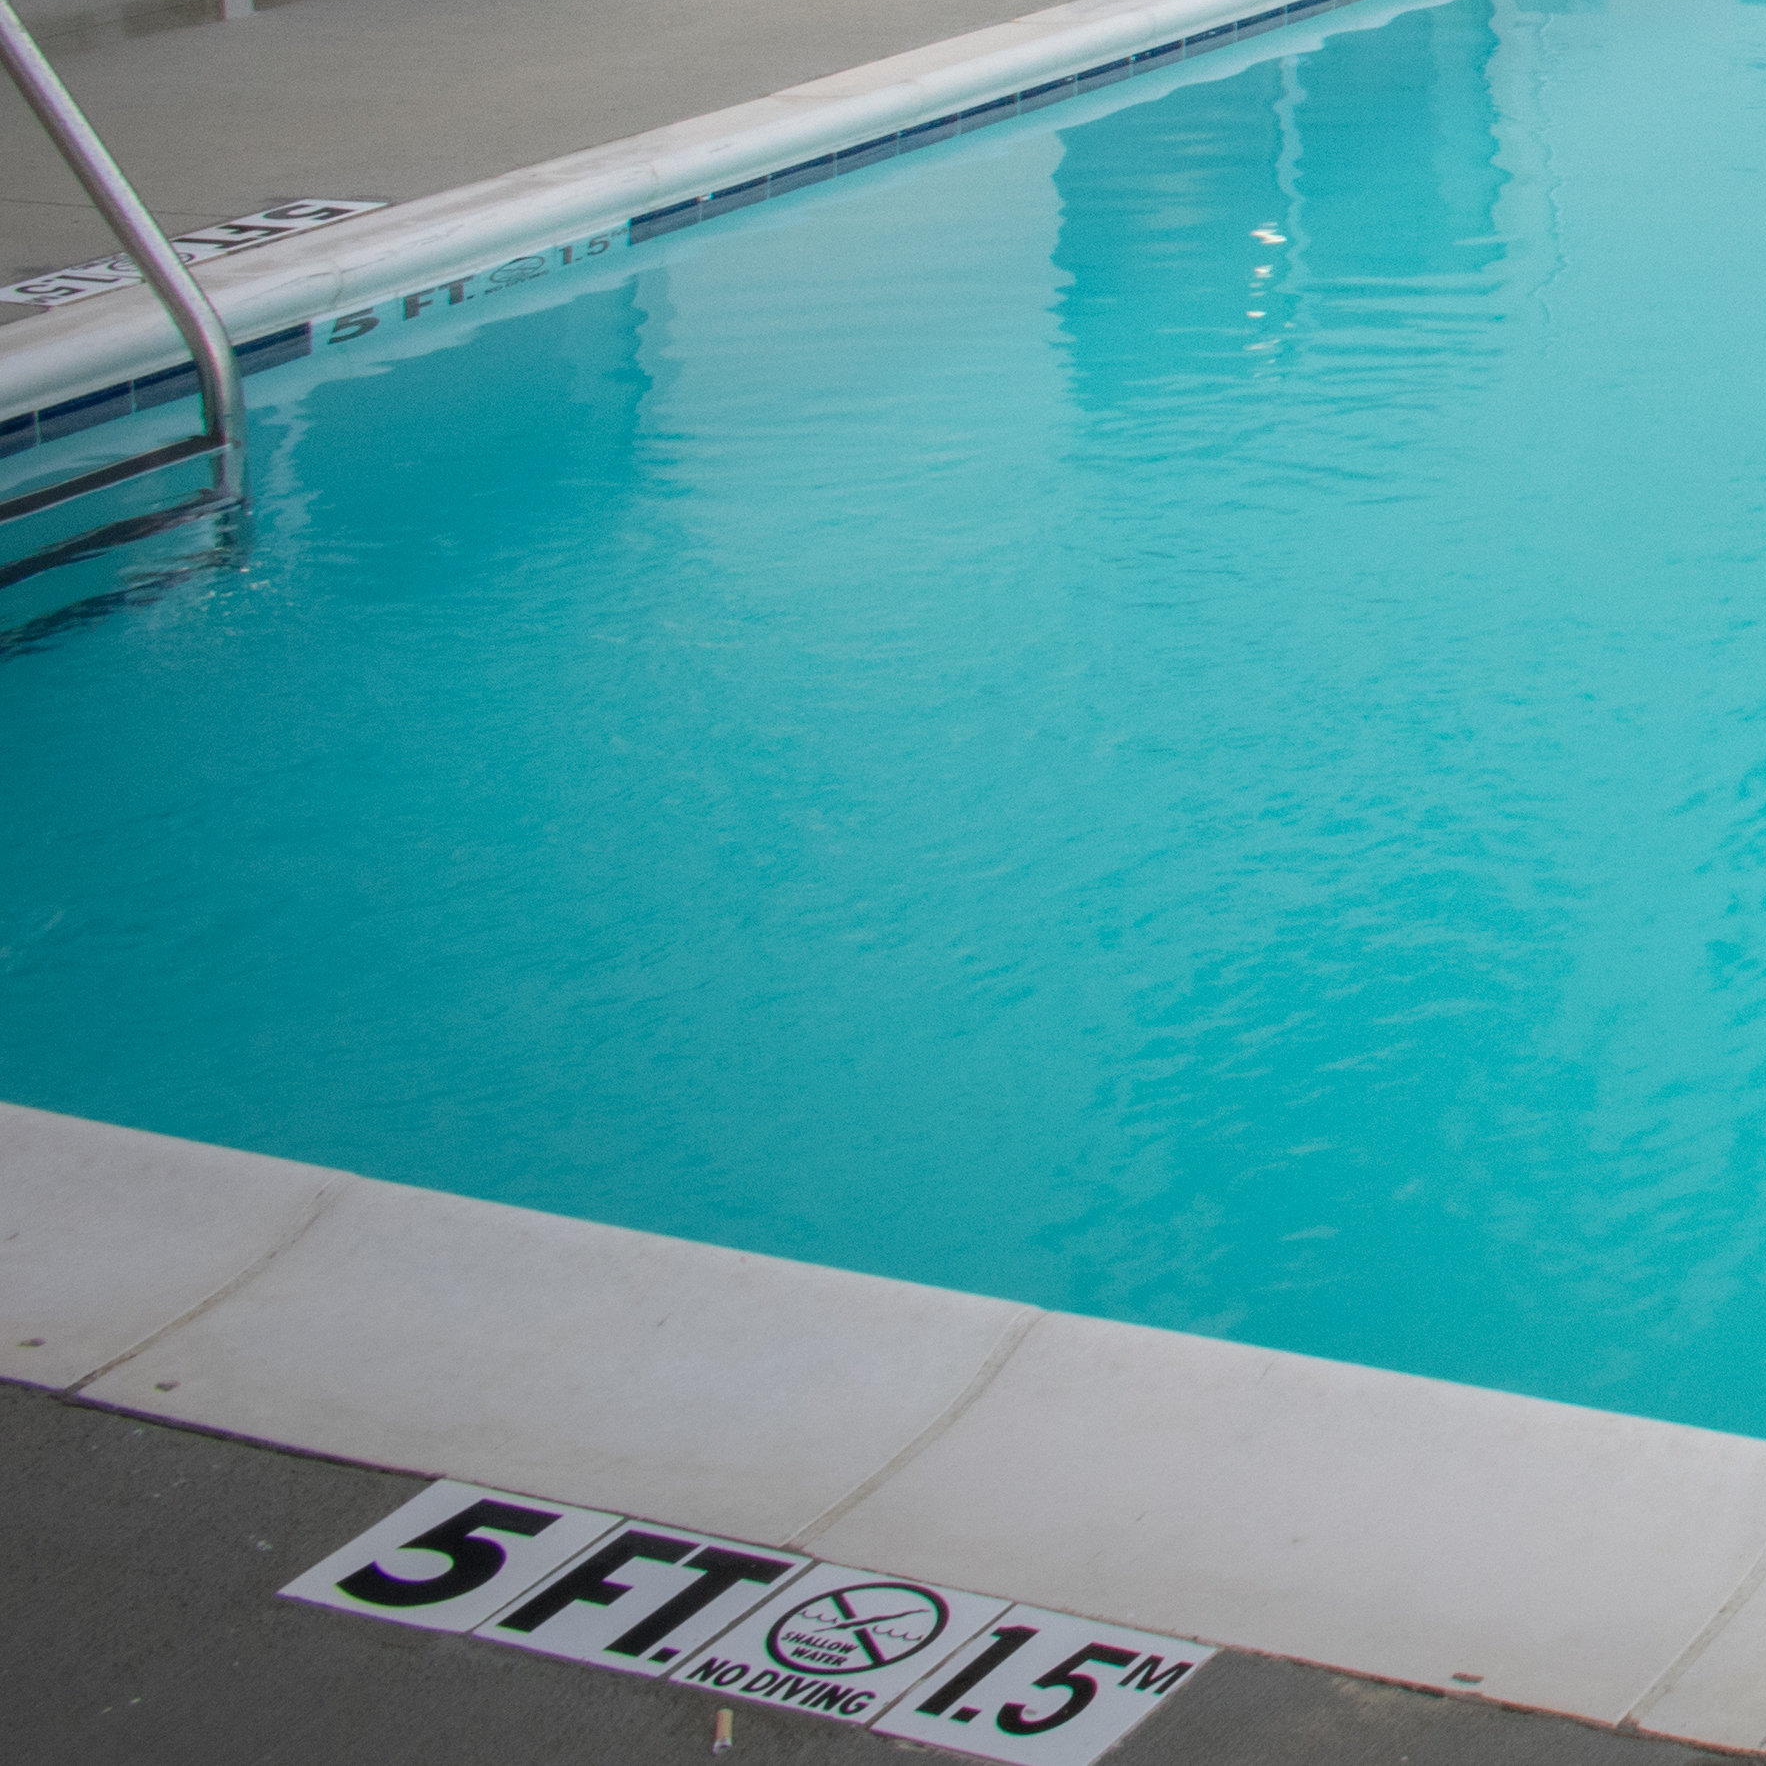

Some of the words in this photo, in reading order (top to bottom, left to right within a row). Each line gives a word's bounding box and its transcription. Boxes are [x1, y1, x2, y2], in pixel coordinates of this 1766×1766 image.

[262, 203, 356, 220] 5
[327, 307, 380, 345] 5
[334, 1497, 565, 1609] 5
[495, 1528, 796, 1664] FT.
[781, 1631, 860, 1655] SHALLOW
[791, 1646, 849, 1667] WATER
[686, 1656, 751, 1687] NO
[738, 1668, 877, 1717] DIVING
